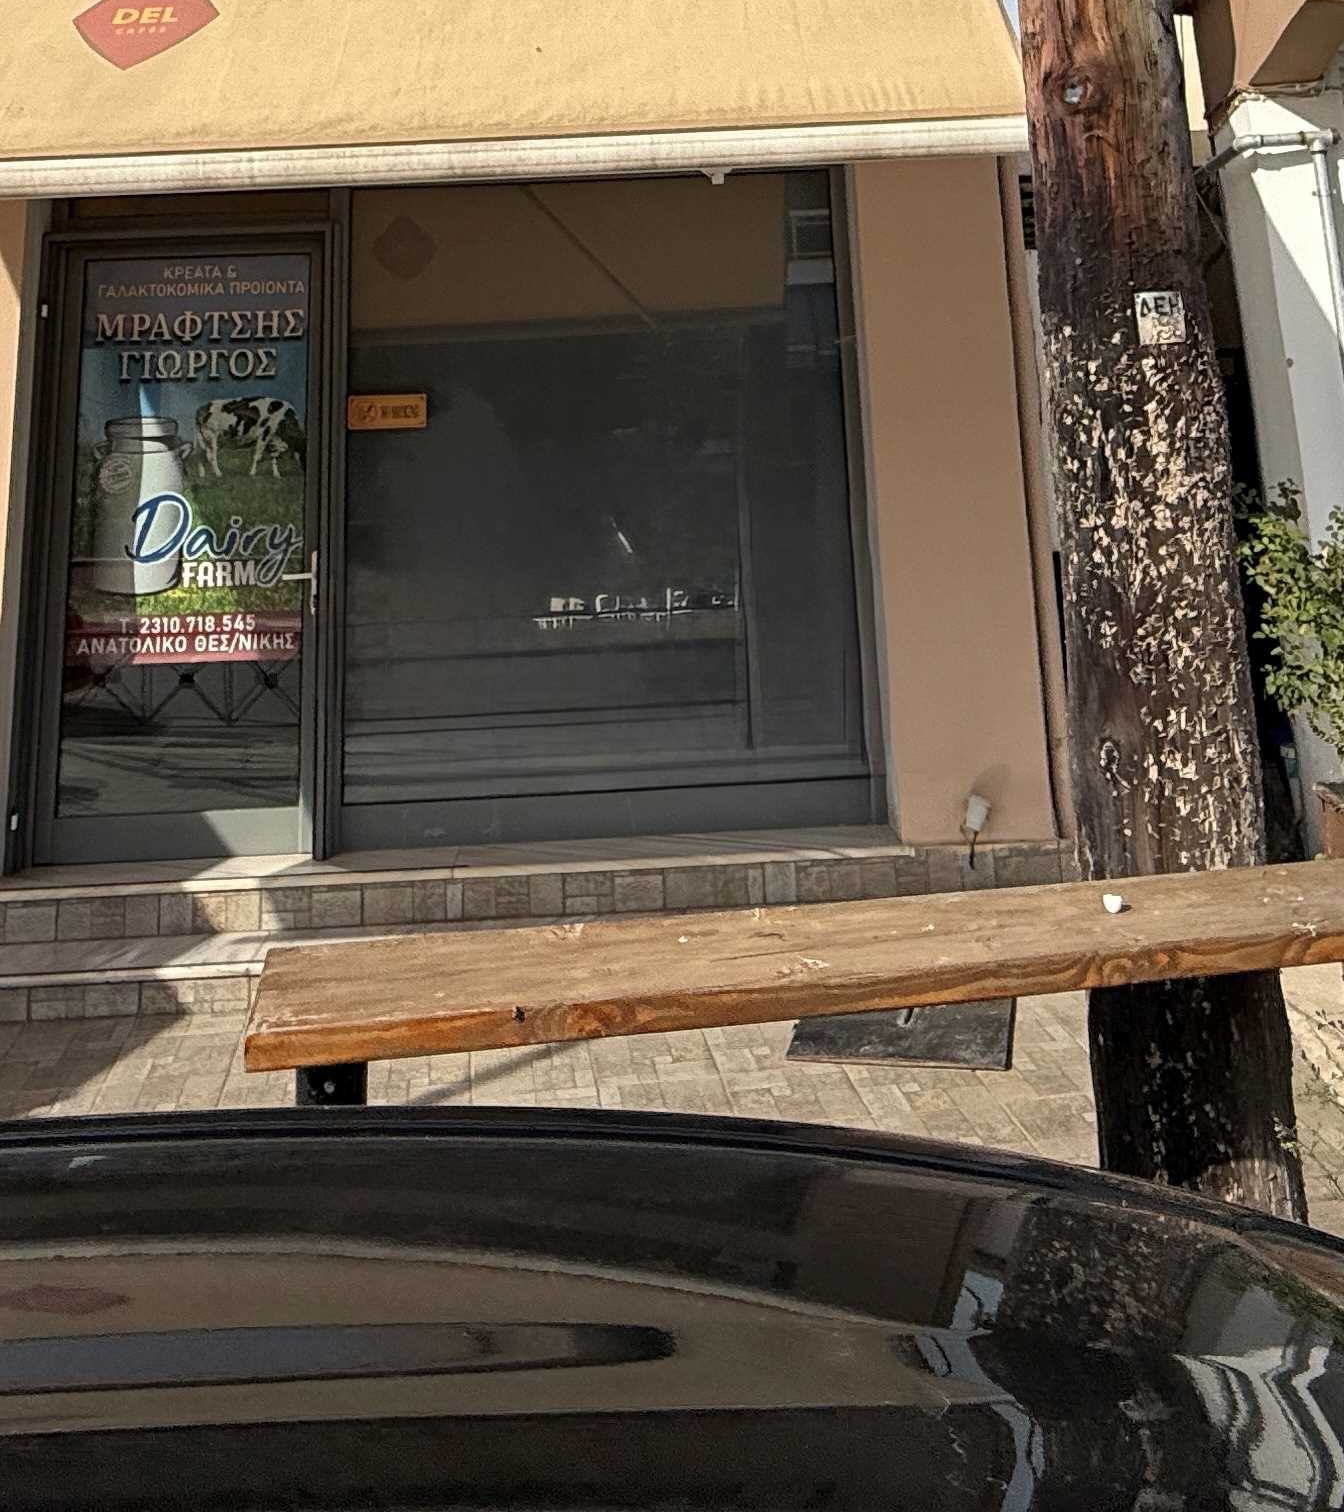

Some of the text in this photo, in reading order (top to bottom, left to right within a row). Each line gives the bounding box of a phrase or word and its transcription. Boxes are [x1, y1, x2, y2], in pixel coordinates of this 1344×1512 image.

[111, 6, 179, 25] DEL
[163, 265, 238, 280] ΚΡΕΑΤΑ &
[97, 283, 225, 298] ΓΑΛΑΚΤΟΚΟΜΙΚΑ
[95, 309, 305, 342] ΜΡΑΦΤΣΗΣ
[119, 347, 278, 380] ΓΙΩΡΓΟΣ
[124, 491, 304, 588] Dairy
[181, 560, 257, 588] FARM
[139, 614, 257, 634] 2310.718.545
[76, 633, 295, 656] ΑΝΑΤΟΛΙΚΟ ΘΕΣ/ΝΙΚΗΣ
